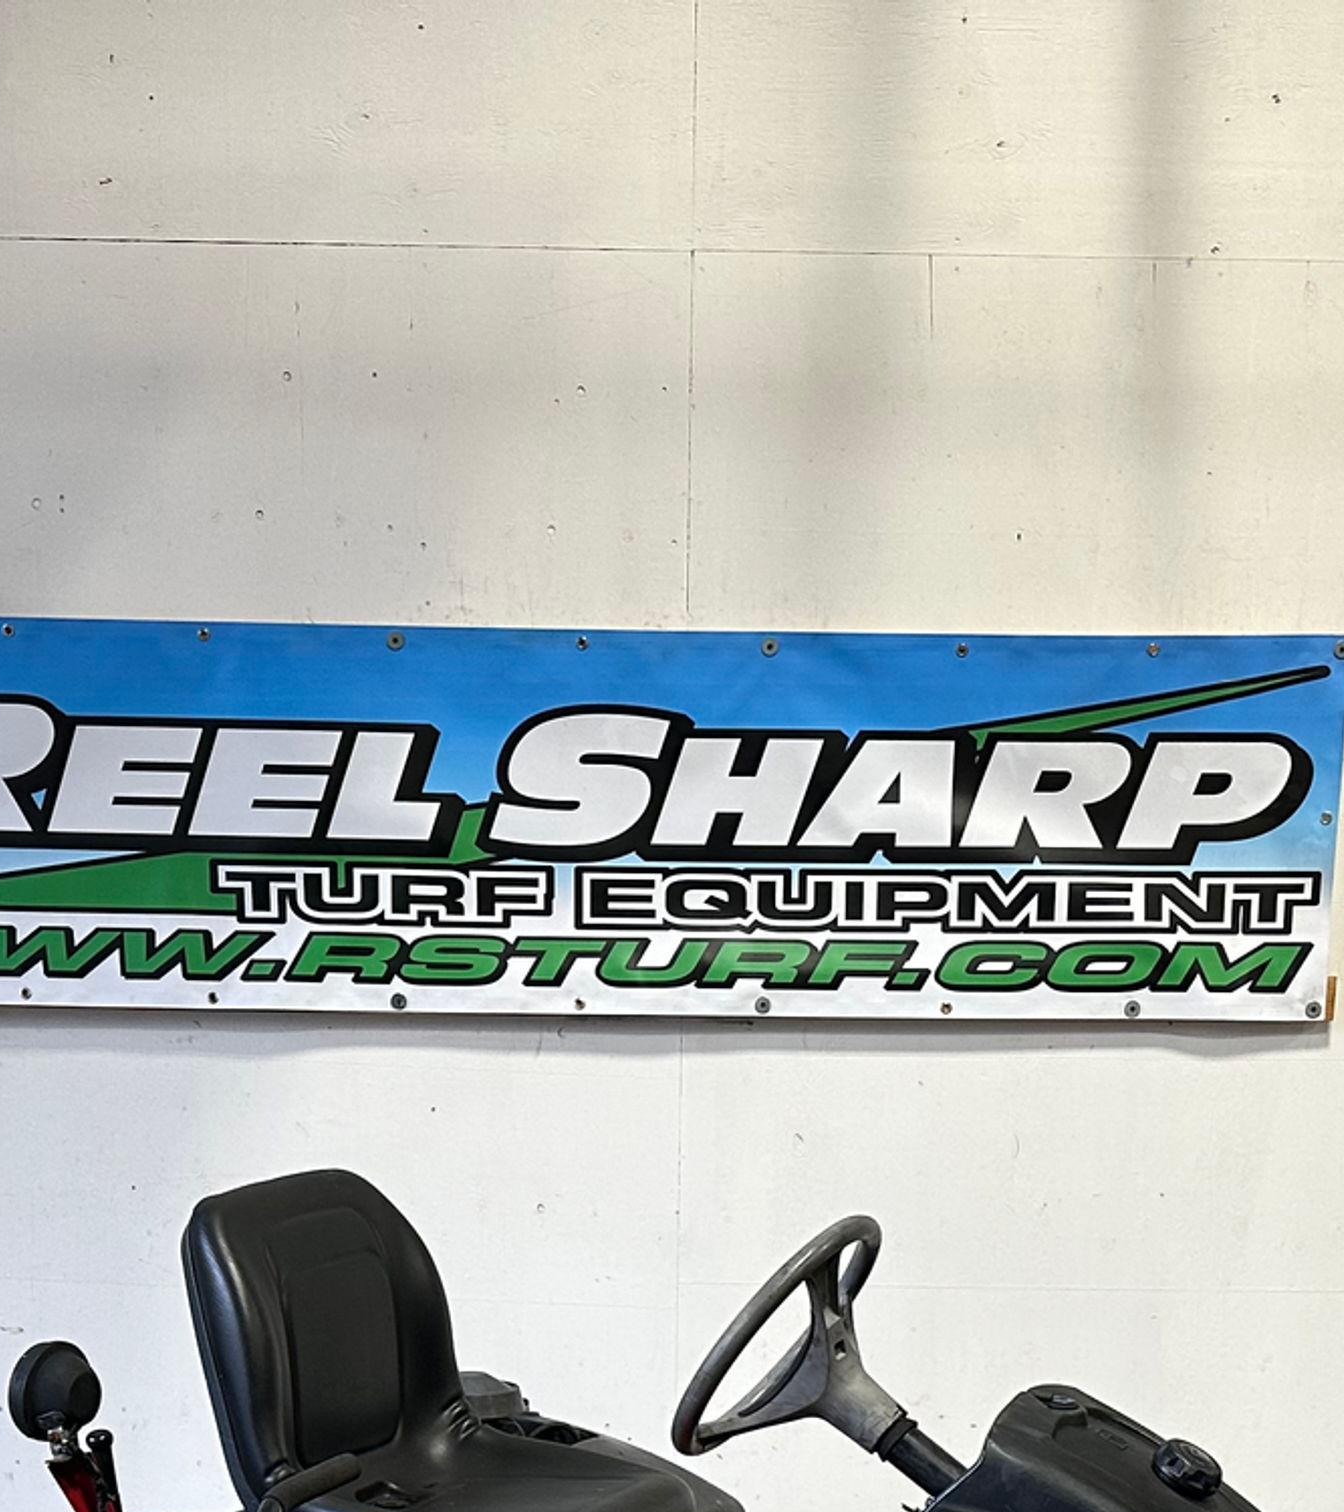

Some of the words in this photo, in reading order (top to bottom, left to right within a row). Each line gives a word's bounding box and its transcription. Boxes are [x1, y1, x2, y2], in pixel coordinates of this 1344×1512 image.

[481, 705, 1307, 861] SHARP
[217, 866, 549, 923] TURF
[579, 871, 1312, 931] EQUIPMENT
